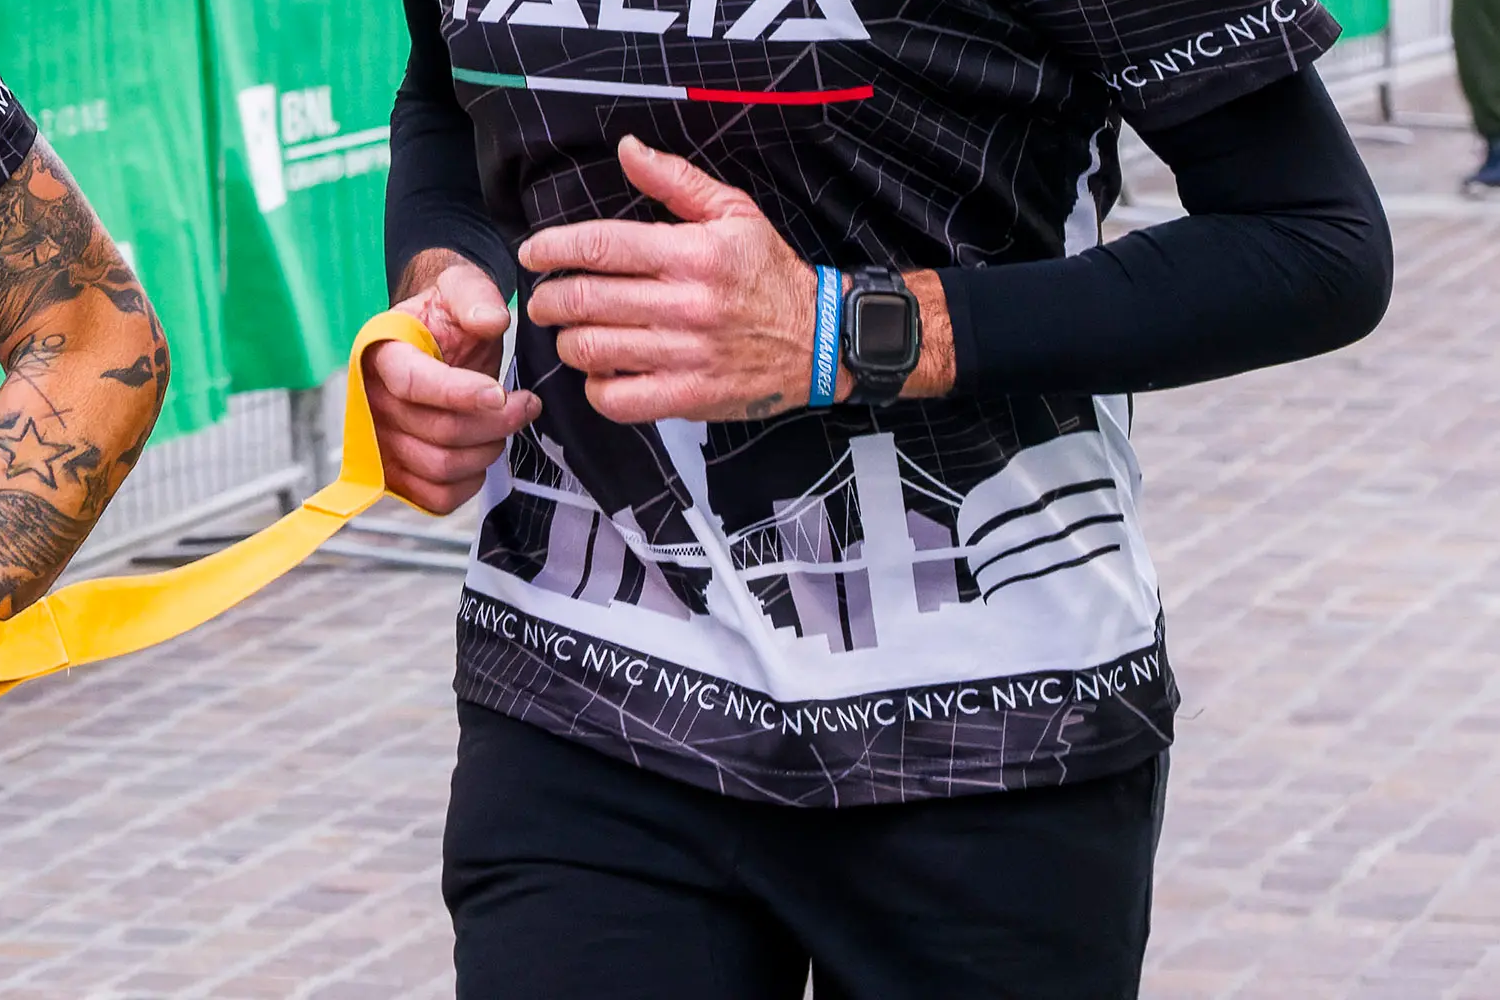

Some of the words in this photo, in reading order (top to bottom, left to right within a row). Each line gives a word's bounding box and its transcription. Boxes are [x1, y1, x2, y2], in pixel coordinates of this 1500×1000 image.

[1103, 64, 1148, 92] YC
[1148, 31, 1223, 80] NYC
[474, 608, 518, 639] NYC
[524, 622, 578, 662] NYC
[582, 643, 650, 686] NYC
[654, 667, 721, 710] NYC
[724, 690, 777, 730] NYC
[781, 706, 838, 736] NYC
[836, 699, 896, 727] NYC
[906, 688, 981, 722] NYC
[991, 677, 1064, 713] NYC
[1075, 665, 1127, 702] NYC
